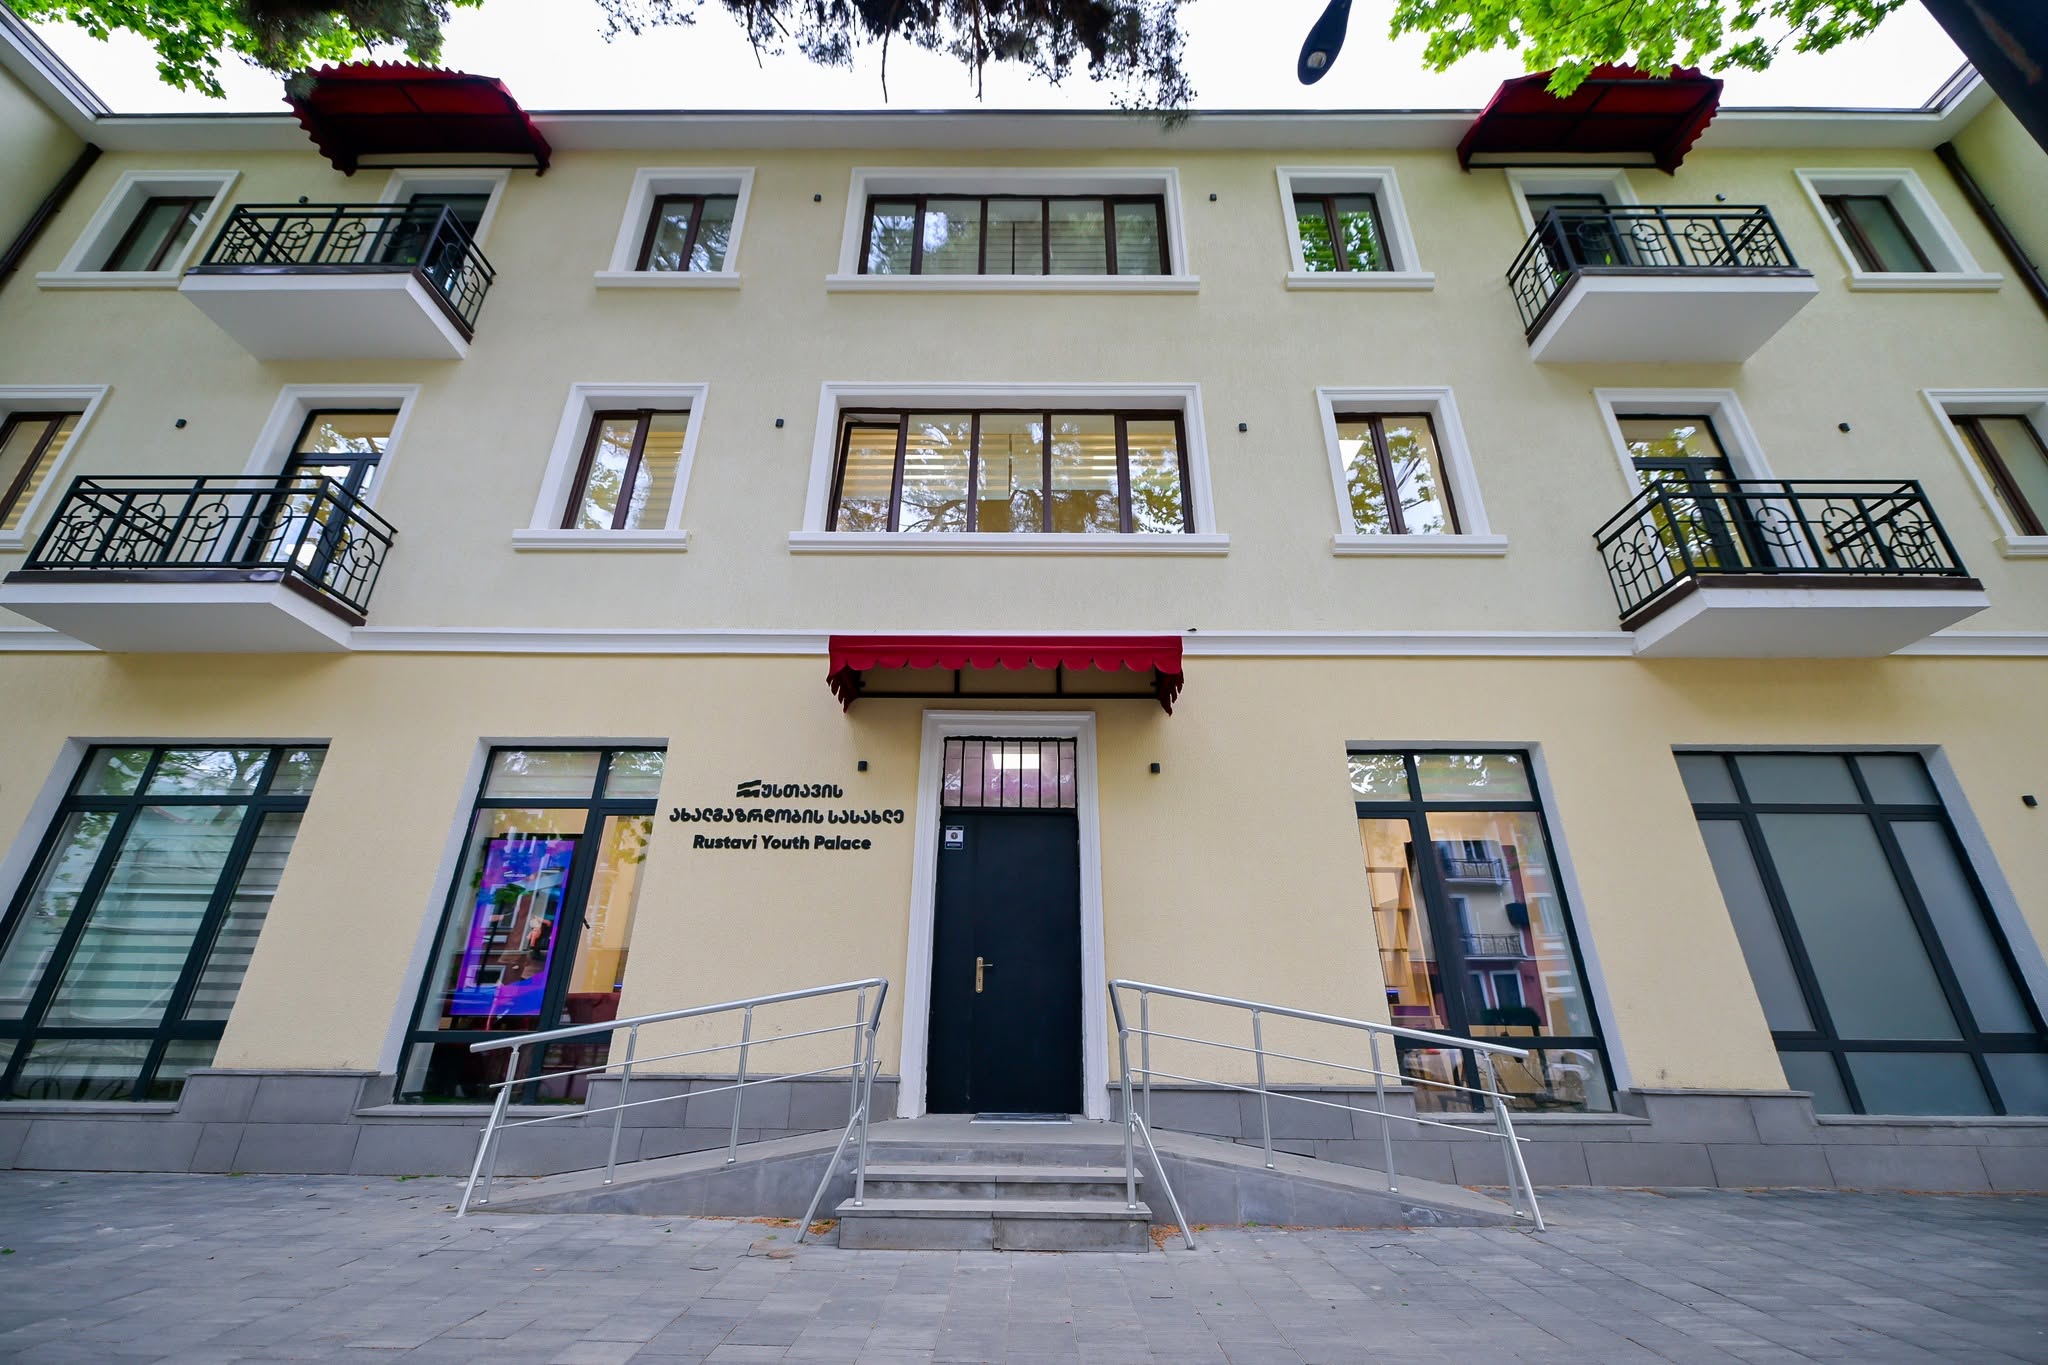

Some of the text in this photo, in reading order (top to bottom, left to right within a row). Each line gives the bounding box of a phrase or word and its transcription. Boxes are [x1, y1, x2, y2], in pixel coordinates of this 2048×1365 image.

[669, 807, 905, 825] ახალგაზრდობის სასახლე
[693, 834, 872, 851] Rustavi Youth Palace
